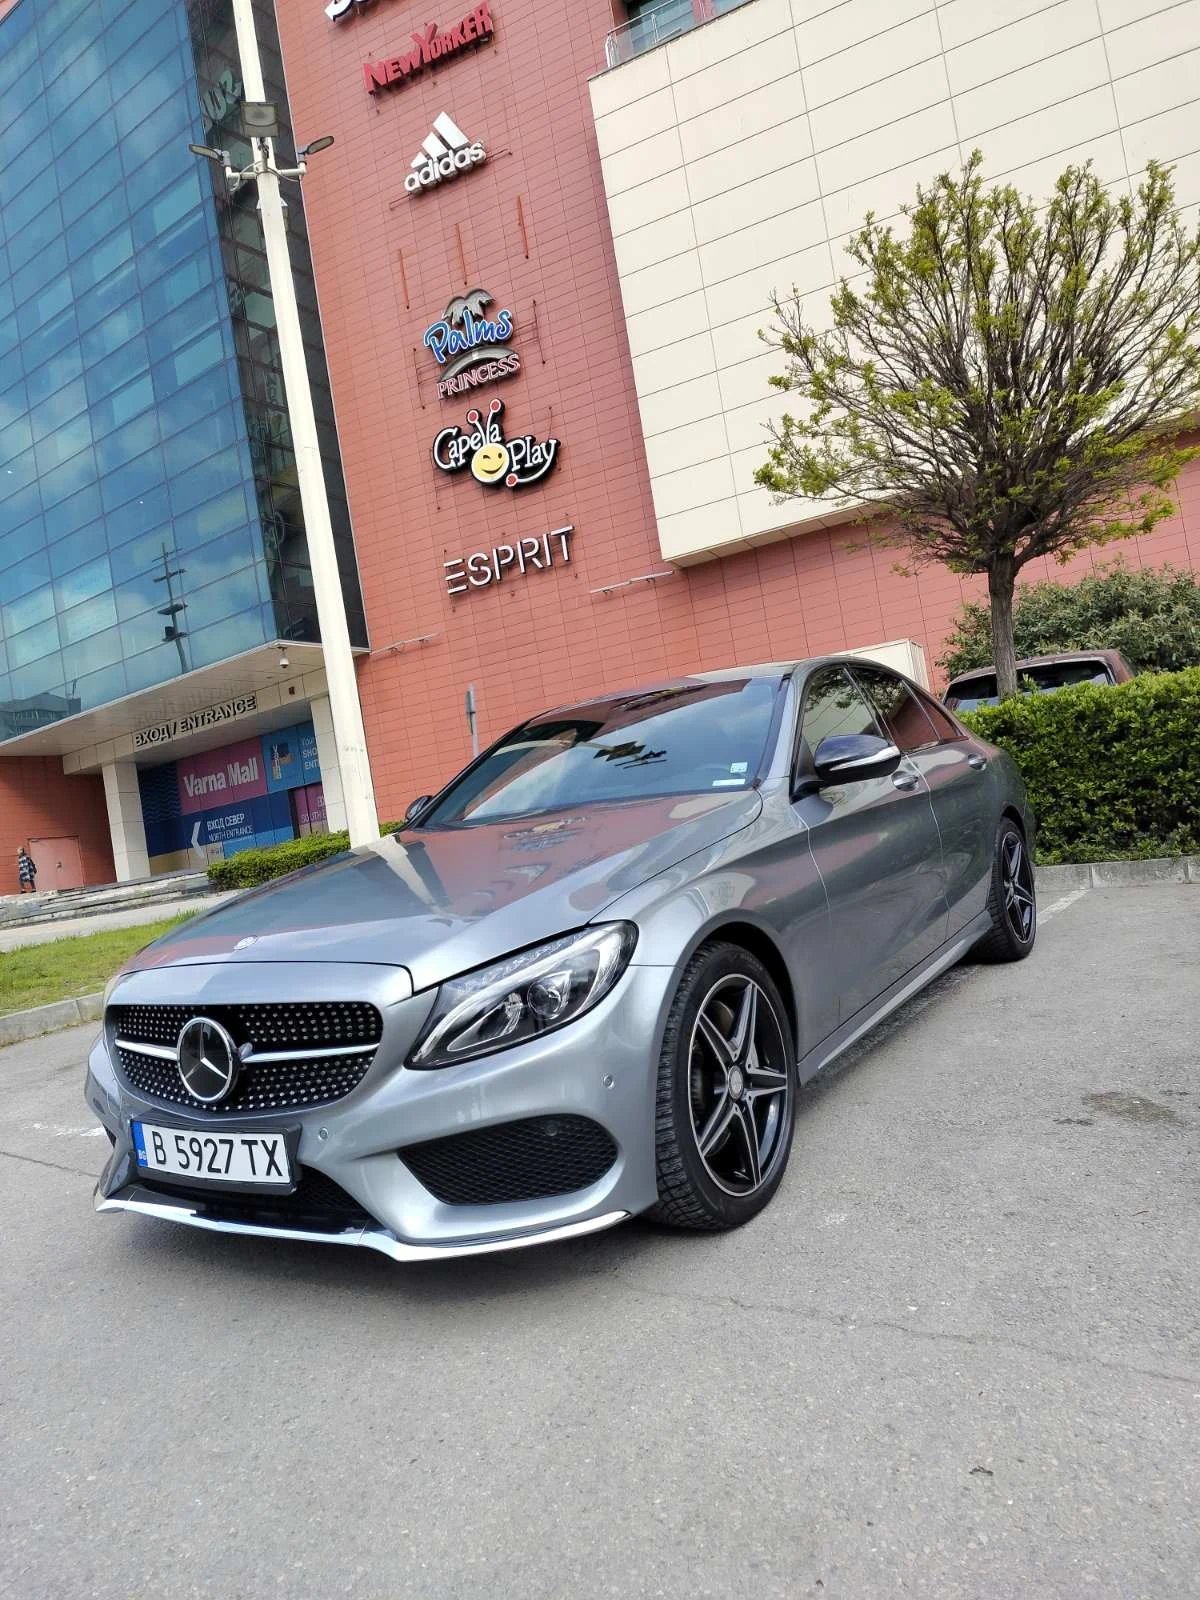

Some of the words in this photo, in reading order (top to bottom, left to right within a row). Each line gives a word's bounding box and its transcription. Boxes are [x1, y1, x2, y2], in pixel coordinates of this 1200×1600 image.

[404, 140, 487, 194] adidas
[424, 307, 513, 363] Palms
[436, 353, 521, 399] PRINCESS
[434, 400, 502, 469] Capella
[507, 435, 558, 486] Play
[443, 525, 575, 595] ESPRIT
[135, 723, 171, 747] ВХОД
[180, 696, 257, 733] ENTRANCE
[303, 748, 318, 759] SHO
[304, 760, 319, 770] ENT
[184, 773, 226, 798] Varna
[227, 757, 259, 787] Mall
[207, 818, 225, 832] ВХОД
[225, 813, 245, 827] СЕВЕР
[209, 831, 226, 842] NORTH
[227, 824, 253, 839] ENTRANCE
[174, 1134, 234, 1174] 5927
[241, 1139, 283, 1176] TX
